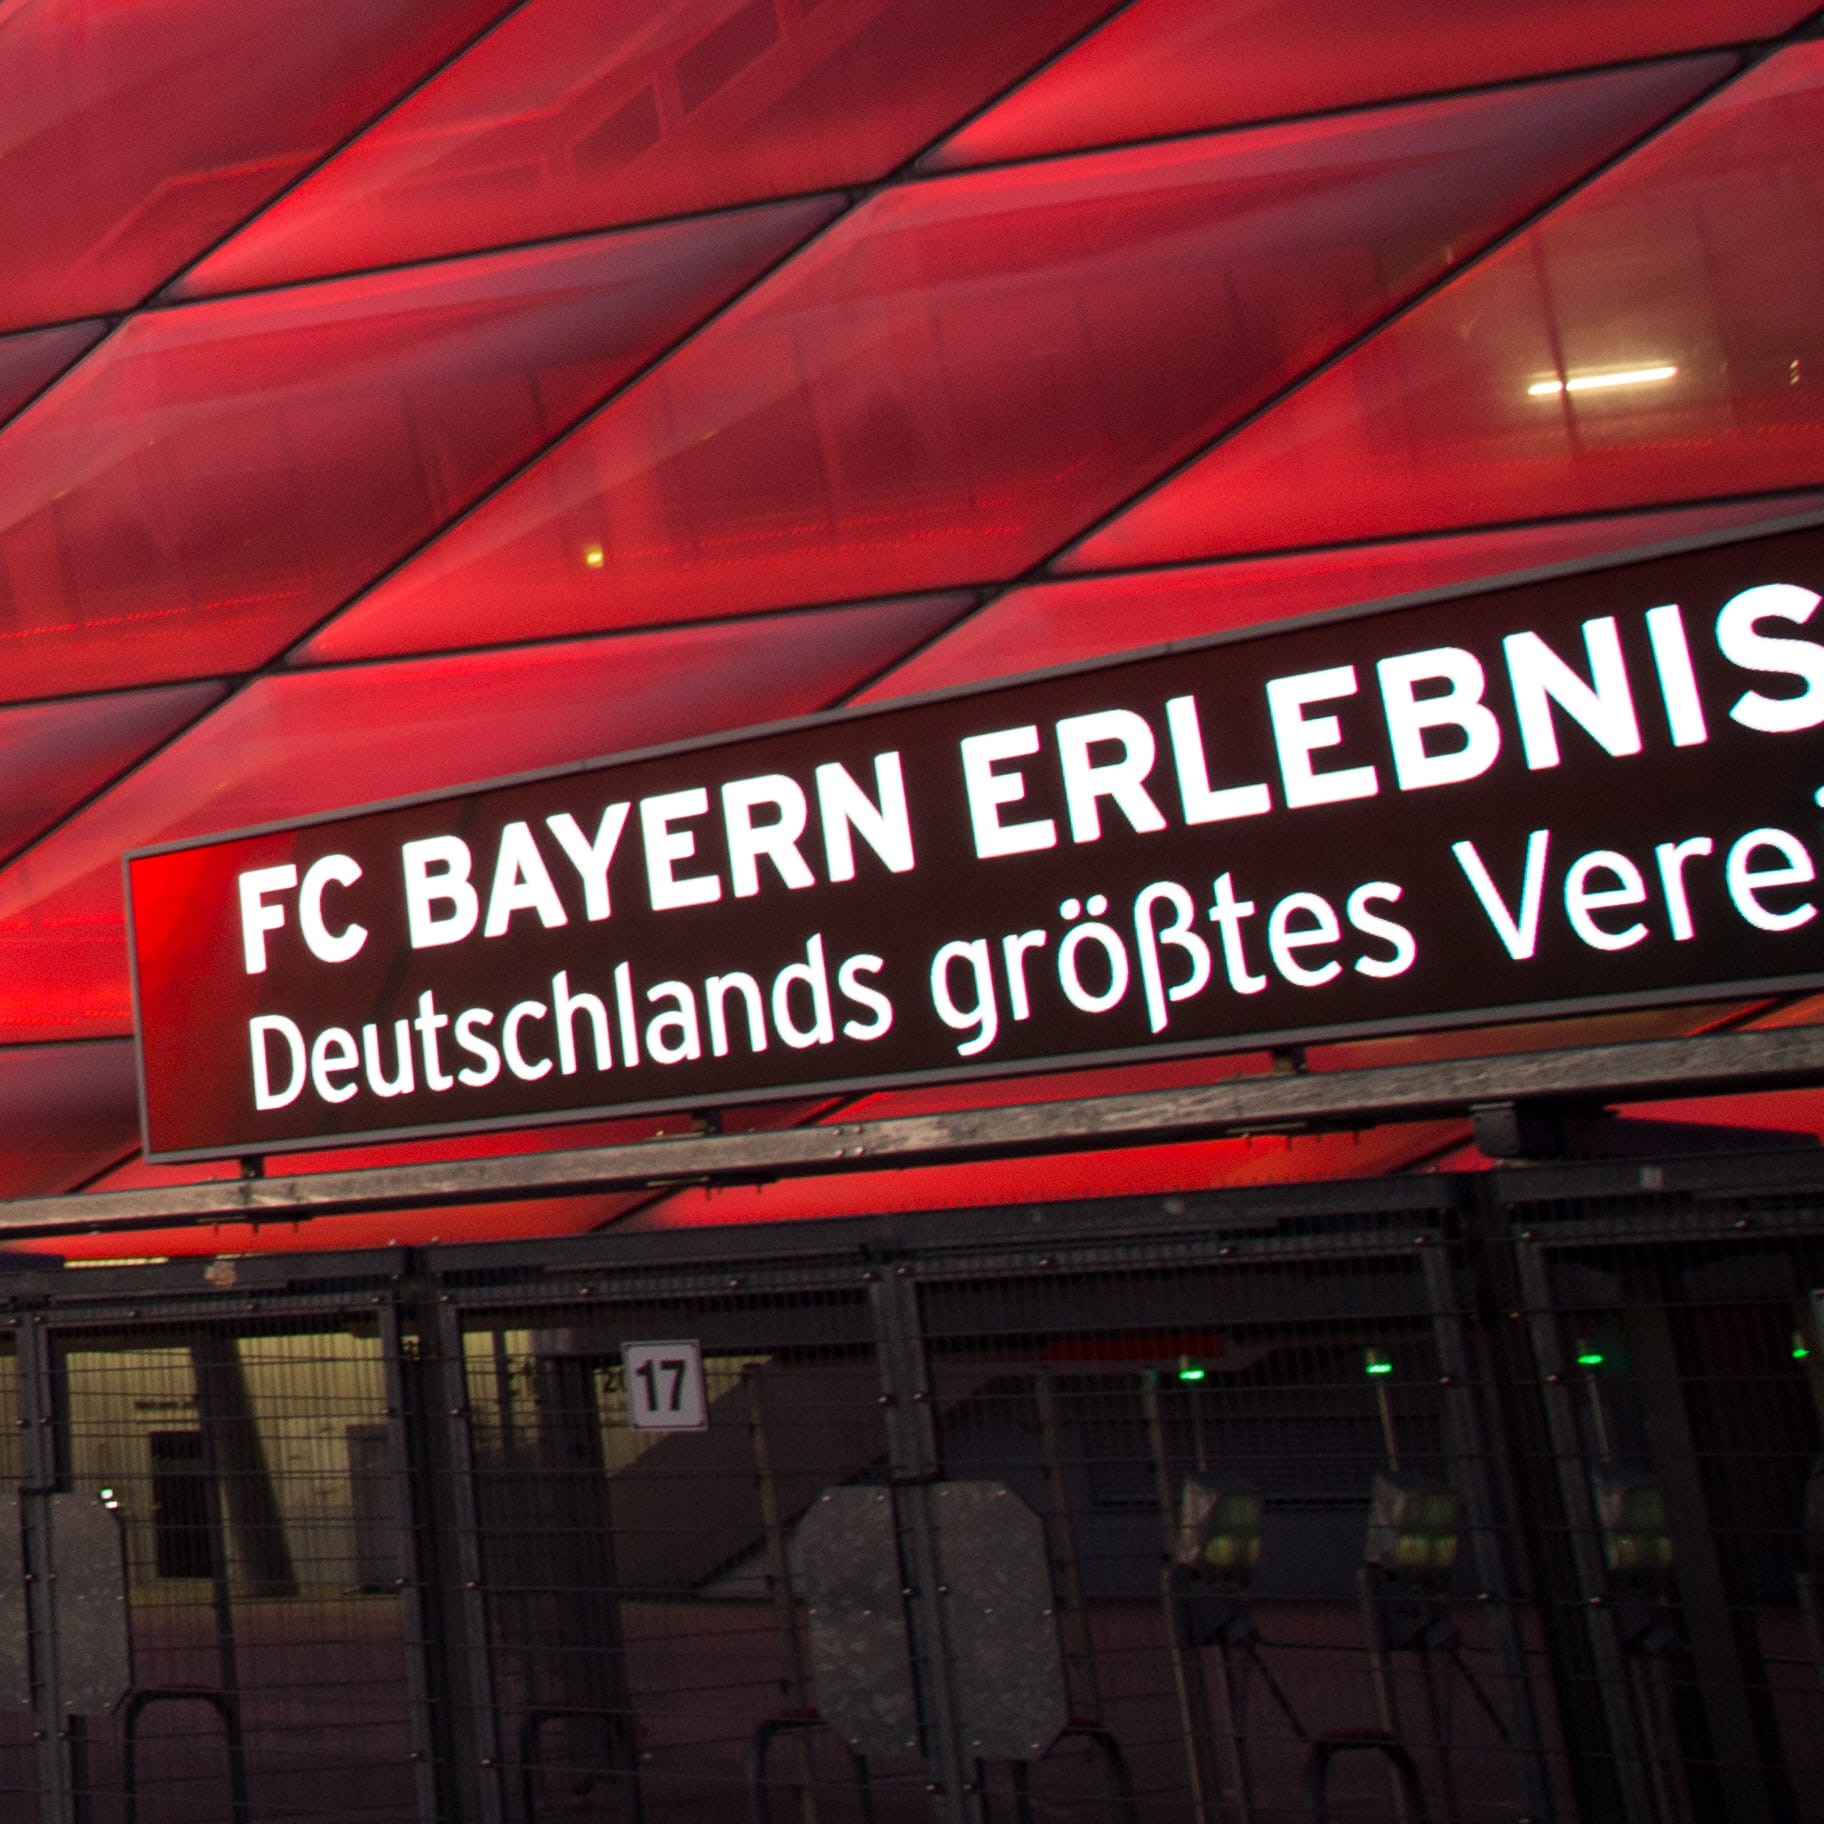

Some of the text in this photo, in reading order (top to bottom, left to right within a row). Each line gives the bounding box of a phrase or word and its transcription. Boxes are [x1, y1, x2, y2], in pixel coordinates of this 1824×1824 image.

[237, 582, 1824, 975] FC BAYERN ERLEBNIS
[248, 784, 1824, 1111] Deutschlands größtes Vere
[635, 1358, 686, 1412] 17
